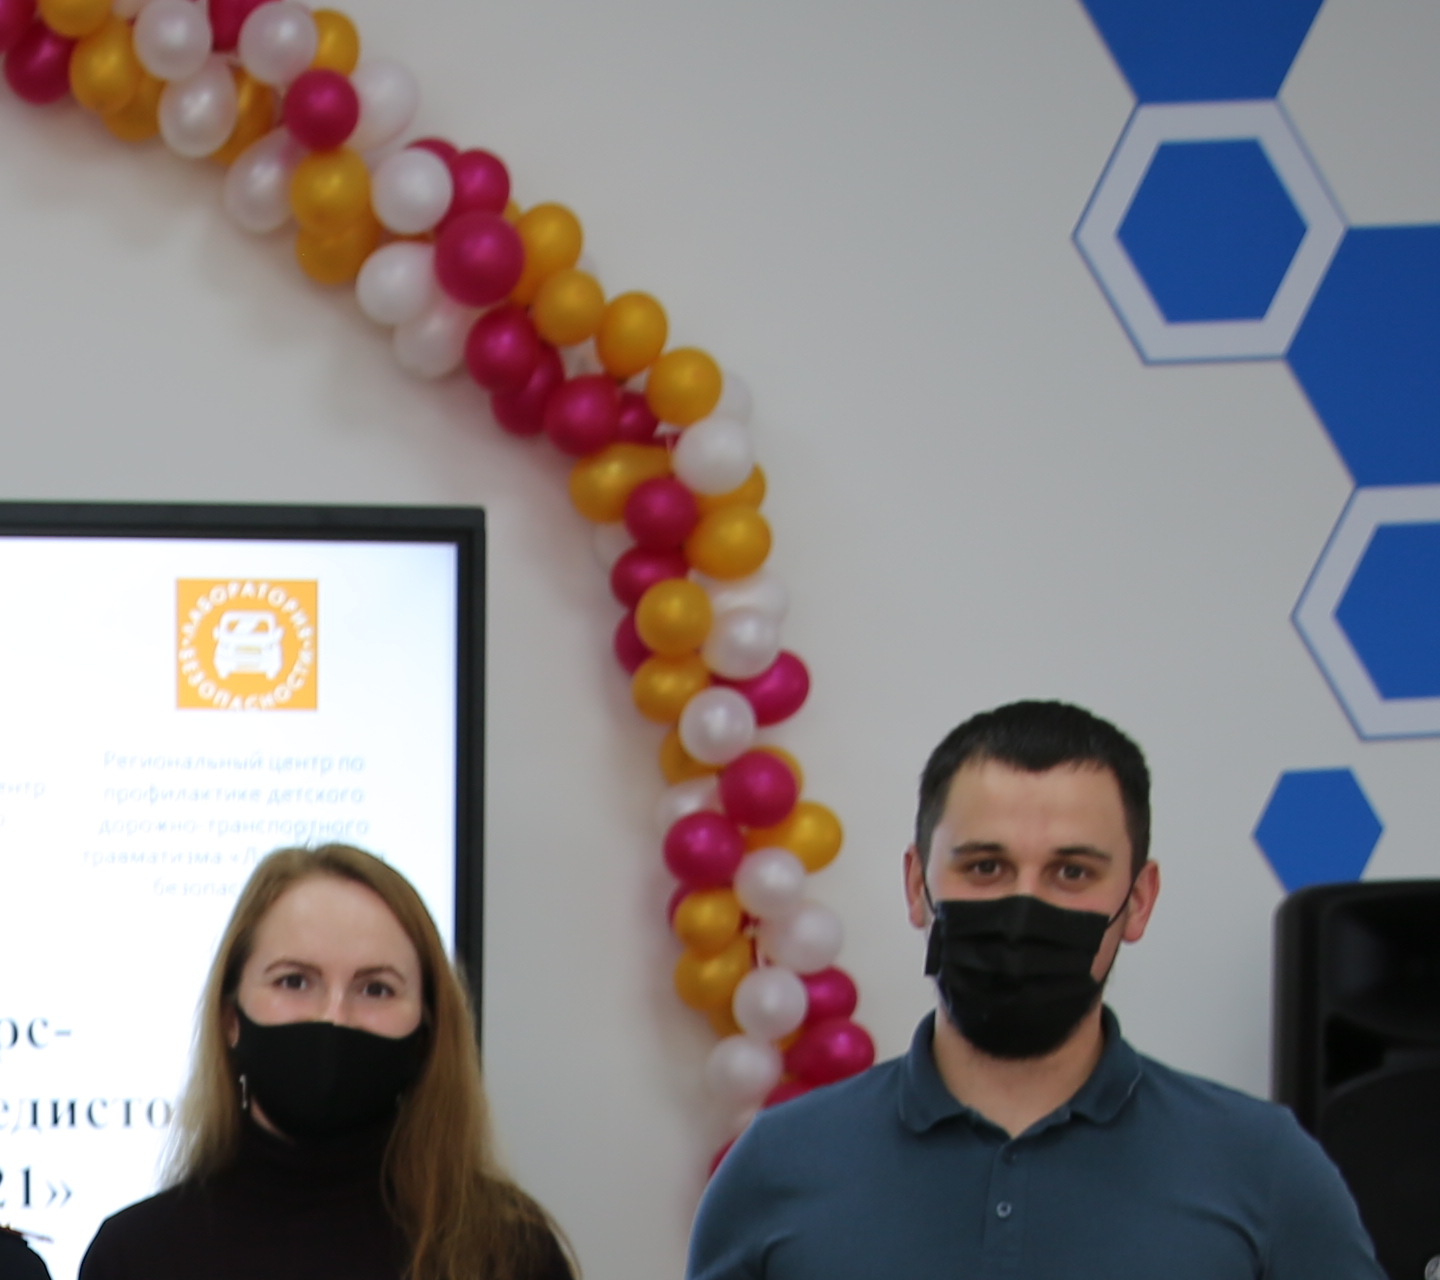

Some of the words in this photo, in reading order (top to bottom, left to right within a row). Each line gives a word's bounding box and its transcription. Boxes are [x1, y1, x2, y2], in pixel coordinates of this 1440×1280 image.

[103, 750, 264, 771] Региональный
[268, 755, 333, 776] центр
[338, 755, 367, 772] по
[103, 784, 262, 805] профилактике
[266, 787, 366, 806] детского
